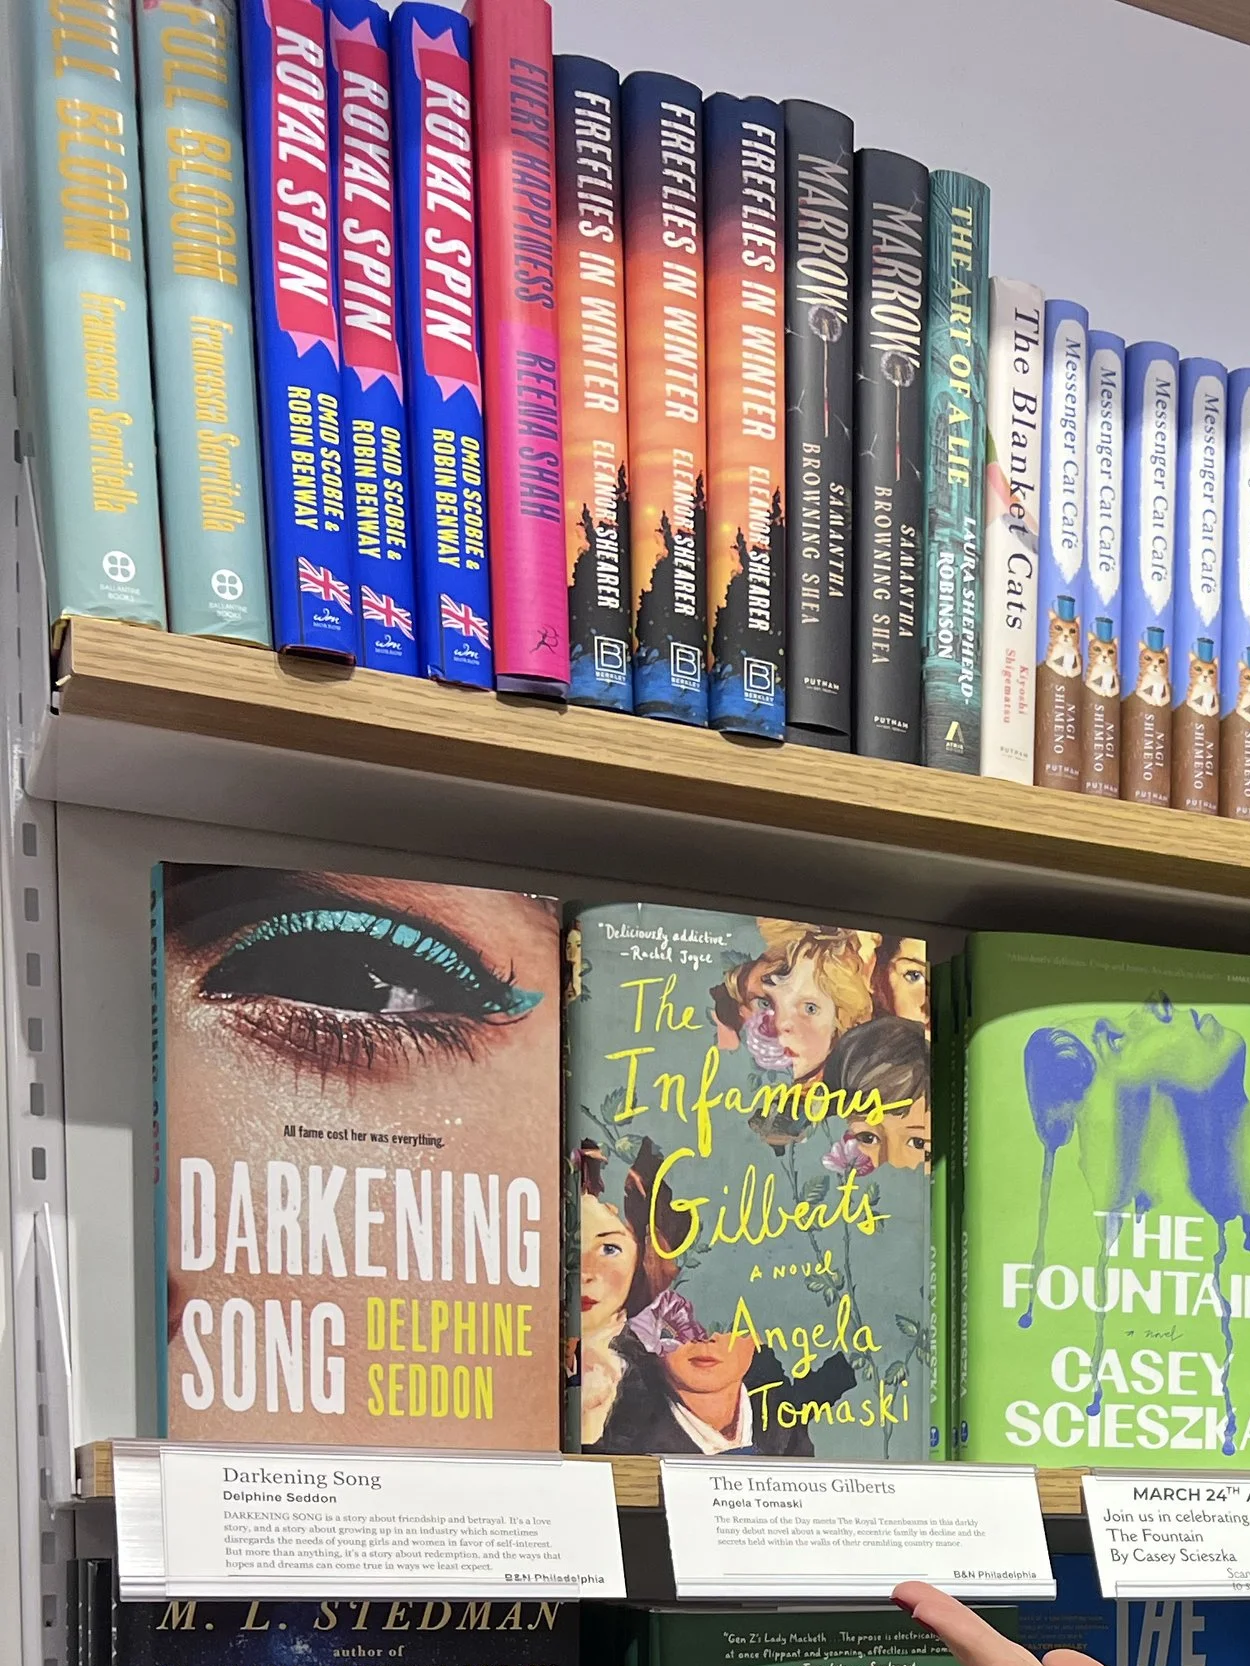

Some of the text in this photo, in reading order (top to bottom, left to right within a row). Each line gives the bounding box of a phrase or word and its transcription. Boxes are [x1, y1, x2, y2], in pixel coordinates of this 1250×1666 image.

[166, 128, 237, 286] BLOOM
[276, 25, 328, 307] ROYAL SPIN
[509, 57, 554, 310] EVERY HAPPINESS
[741, 121, 776, 441] FIREFLIES IN WINTER
[796, 154, 853, 326] MARROW
[947, 205, 975, 490] THE ART OF A LIE
[288, 385, 319, 530] ROBIN BENWAY
[516, 351, 560, 523] REENA SHAH
[1003, 307, 1041, 633] The Blanket Cats
[1059, 337, 1082, 552] Messenger Cat Café
[747, 466, 771, 630] ELEANOR SHEARER
[619, 976, 703, 1036] The
[283, 1124, 445, 1149] All fame cost her was everything.
[606, 1047, 914, 1158] Infamous
[180, 1157, 541, 1288] DARKENING
[649, 1152, 891, 1260] Gilberts
[1093, 1211, 1205, 1262] THE
[181, 1299, 345, 1415] SONG
[367, 1296, 533, 1358] DELPHINE
[726, 1297, 882, 1379] Angela
[368, 1364, 493, 1419] SEDDON
[747, 1383, 909, 1432] Tomaski
[1051, 1346, 1235, 1398] CASEY
[222, 1467, 382, 1490] Darkening Song
[223, 1490, 337, 1505] Delphine Seddon
[710, 1477, 896, 1495] The Infamous Gilberts
[1103, 1508, 1250, 1526] Join us in celebrating
[1133, 1487, 1200, 1501] MARCH
[1106, 1528, 1204, 1543] The Fountain
[1110, 1548, 1238, 1565] By Casey Scieszka
[333, 1645, 404, 1659] author of
